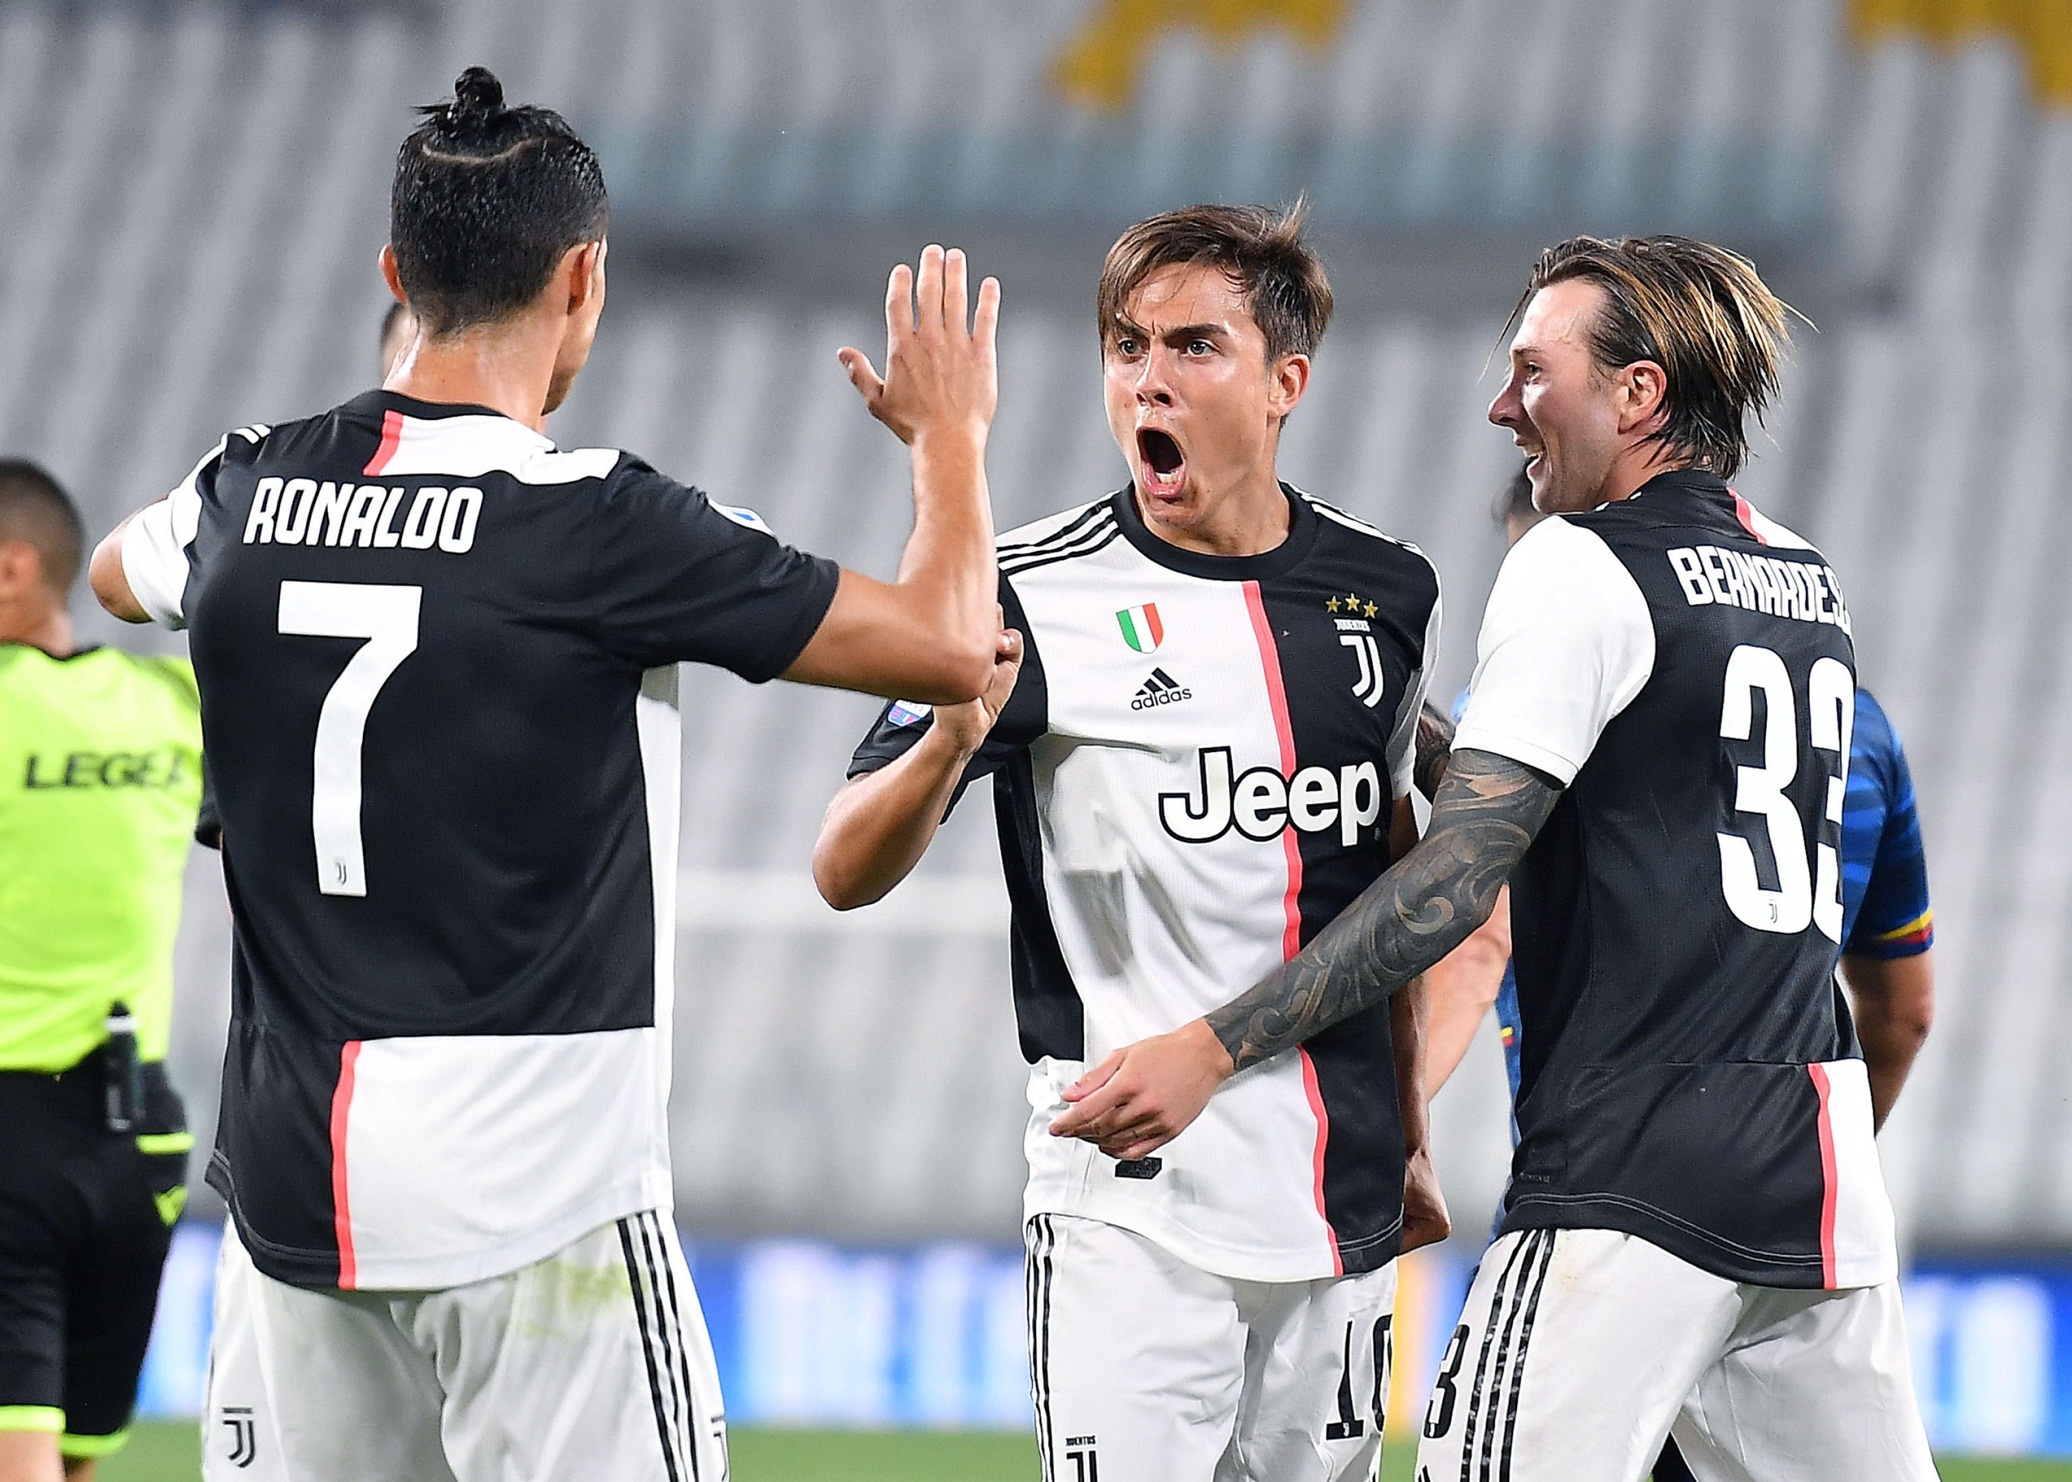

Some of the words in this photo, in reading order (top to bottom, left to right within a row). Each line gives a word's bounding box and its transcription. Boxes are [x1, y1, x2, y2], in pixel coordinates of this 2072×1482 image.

[243, 477, 484, 554] RONALDO
[277, 580, 423, 897] 7
[1131, 686, 1192, 710] adidas
[1158, 745, 1381, 848] Jeep
[1716, 643, 1856, 945] 33
